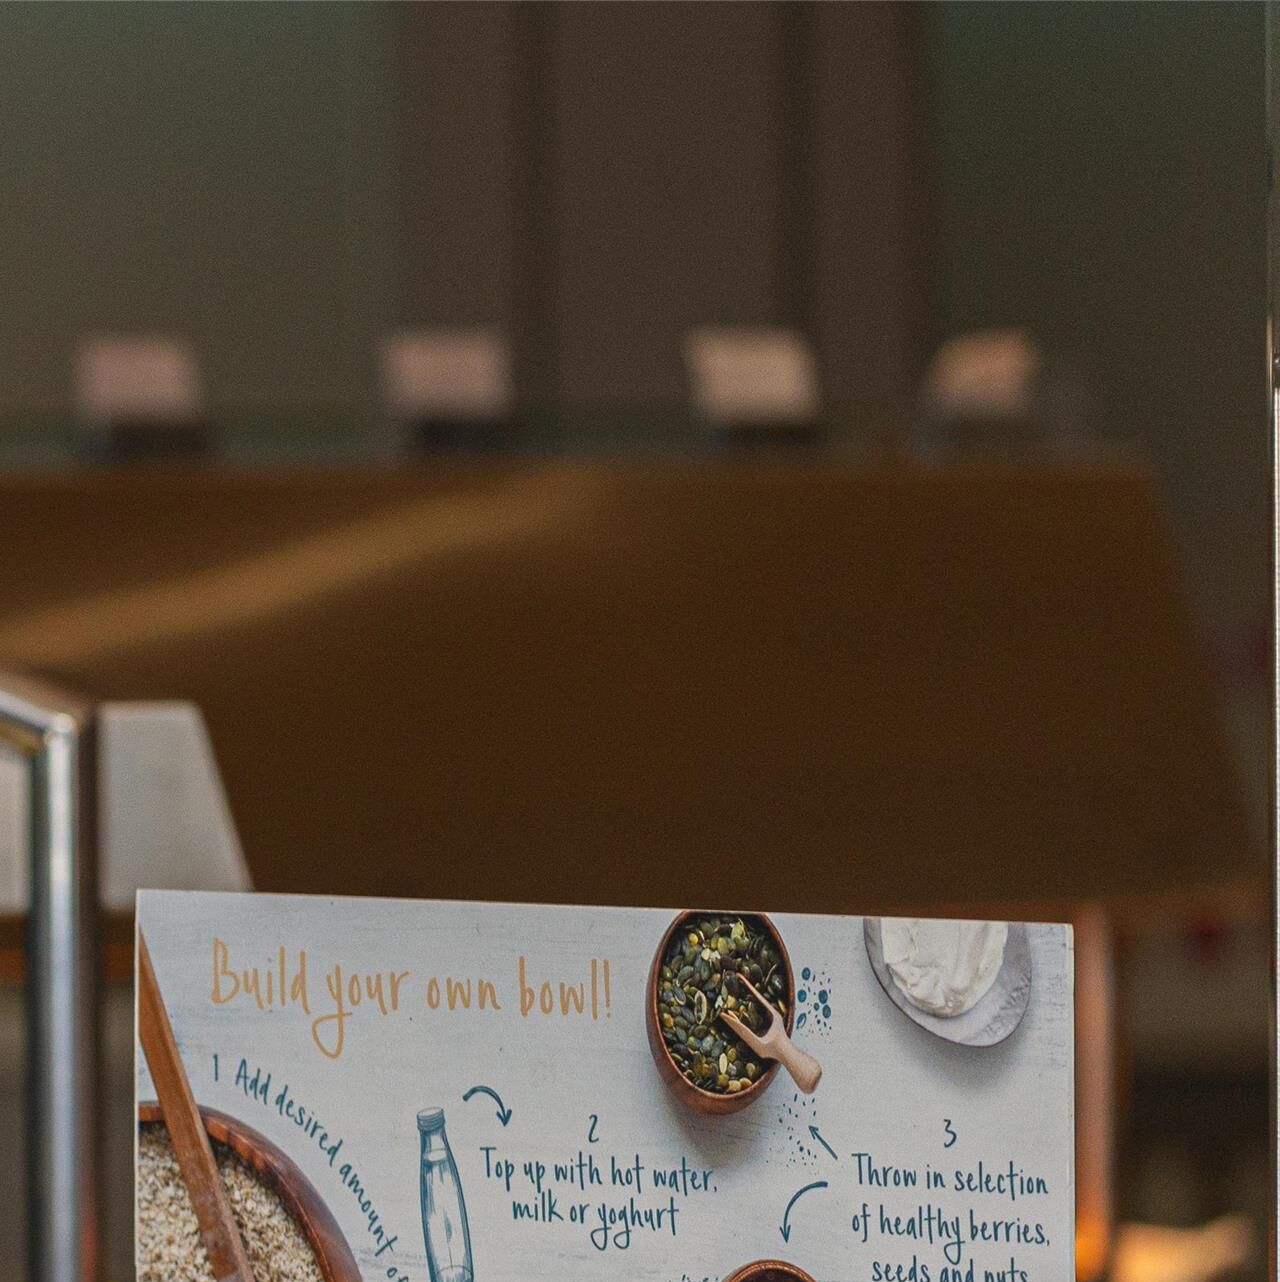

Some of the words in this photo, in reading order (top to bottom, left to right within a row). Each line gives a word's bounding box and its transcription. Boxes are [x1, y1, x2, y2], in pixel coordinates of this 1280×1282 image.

[211, 938, 310, 1014] Build
[312, 965, 410, 1058] your
[427, 972, 501, 1011] own
[518, 955, 610, 1020] bowl!
[212, 1053, 219, 1082] 1
[235, 1058, 271, 1105] Add
[275, 1085, 343, 1167] desired
[339, 1163, 398, 1257] amount
[588, 1114, 599, 1143] 2
[943, 1118, 957, 1148] 3
[480, 1147, 515, 1192] Top
[523, 1160, 545, 1194] up
[554, 1151, 603, 1191] with
[611, 1154, 645, 1194] hot
[851, 1153, 917, 1187] Throw
[926, 1164, 946, 1189] in
[954, 1160, 1049, 1201] selection
[512, 1188, 564, 1222] milk
[569, 1203, 590, 1224] or
[590, 1197, 679, 1251] yoghurt
[852, 1203, 871, 1243] of
[880, 1204, 966, 1265] healthy
